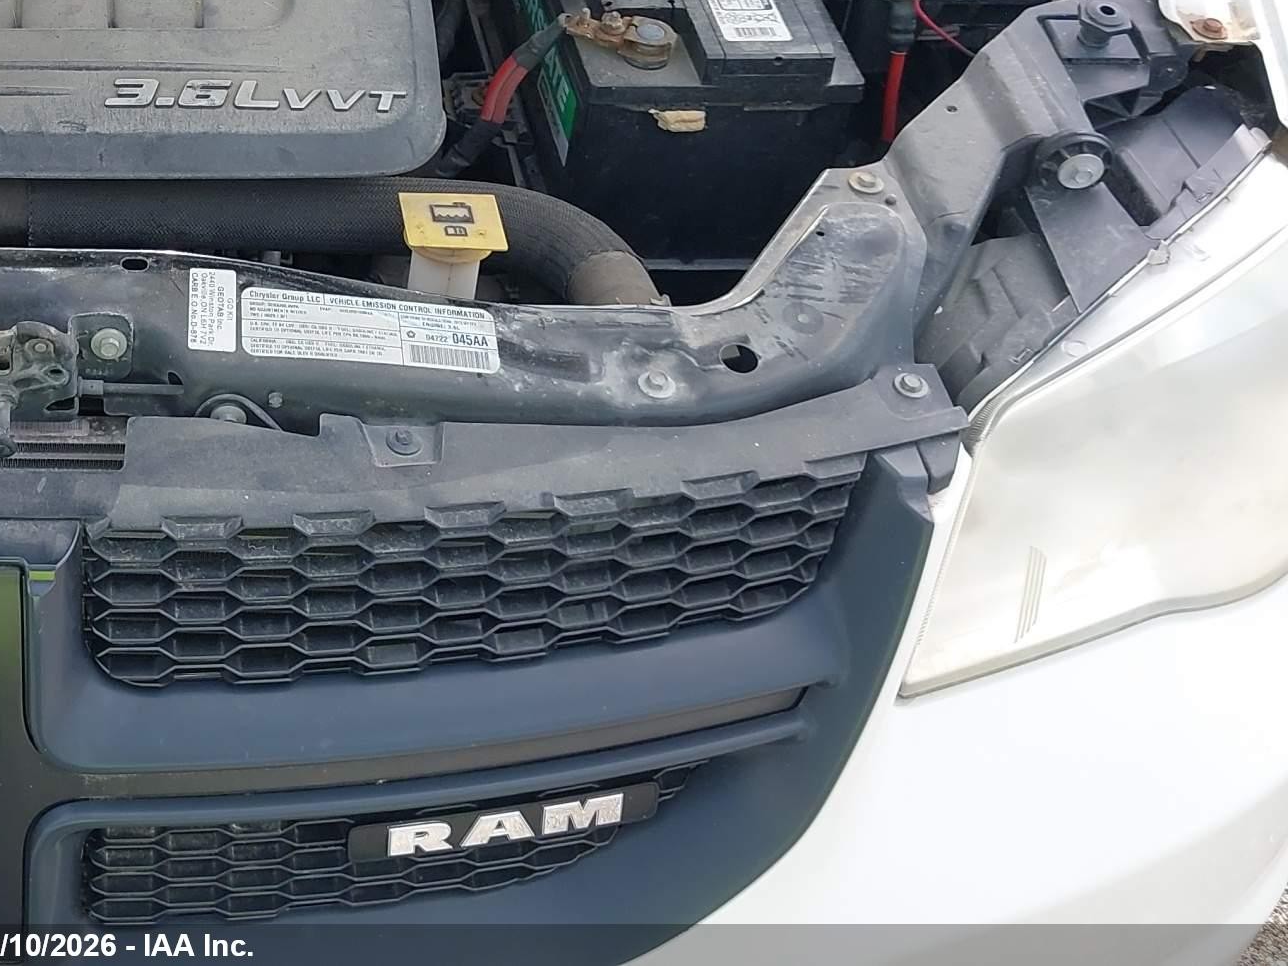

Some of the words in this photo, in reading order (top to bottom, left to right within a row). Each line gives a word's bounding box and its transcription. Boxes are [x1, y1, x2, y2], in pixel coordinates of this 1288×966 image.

[249, 290, 279, 299] Chrysler
[281, 293, 304, 301] Group
[329, 297, 358, 306] VEHICLE
[361, 300, 396, 310] EMISSION
[398, 304, 431, 313] CONTROL
[434, 307, 485, 318] INFORMATION
[387, 793, 624, 857] RAM
